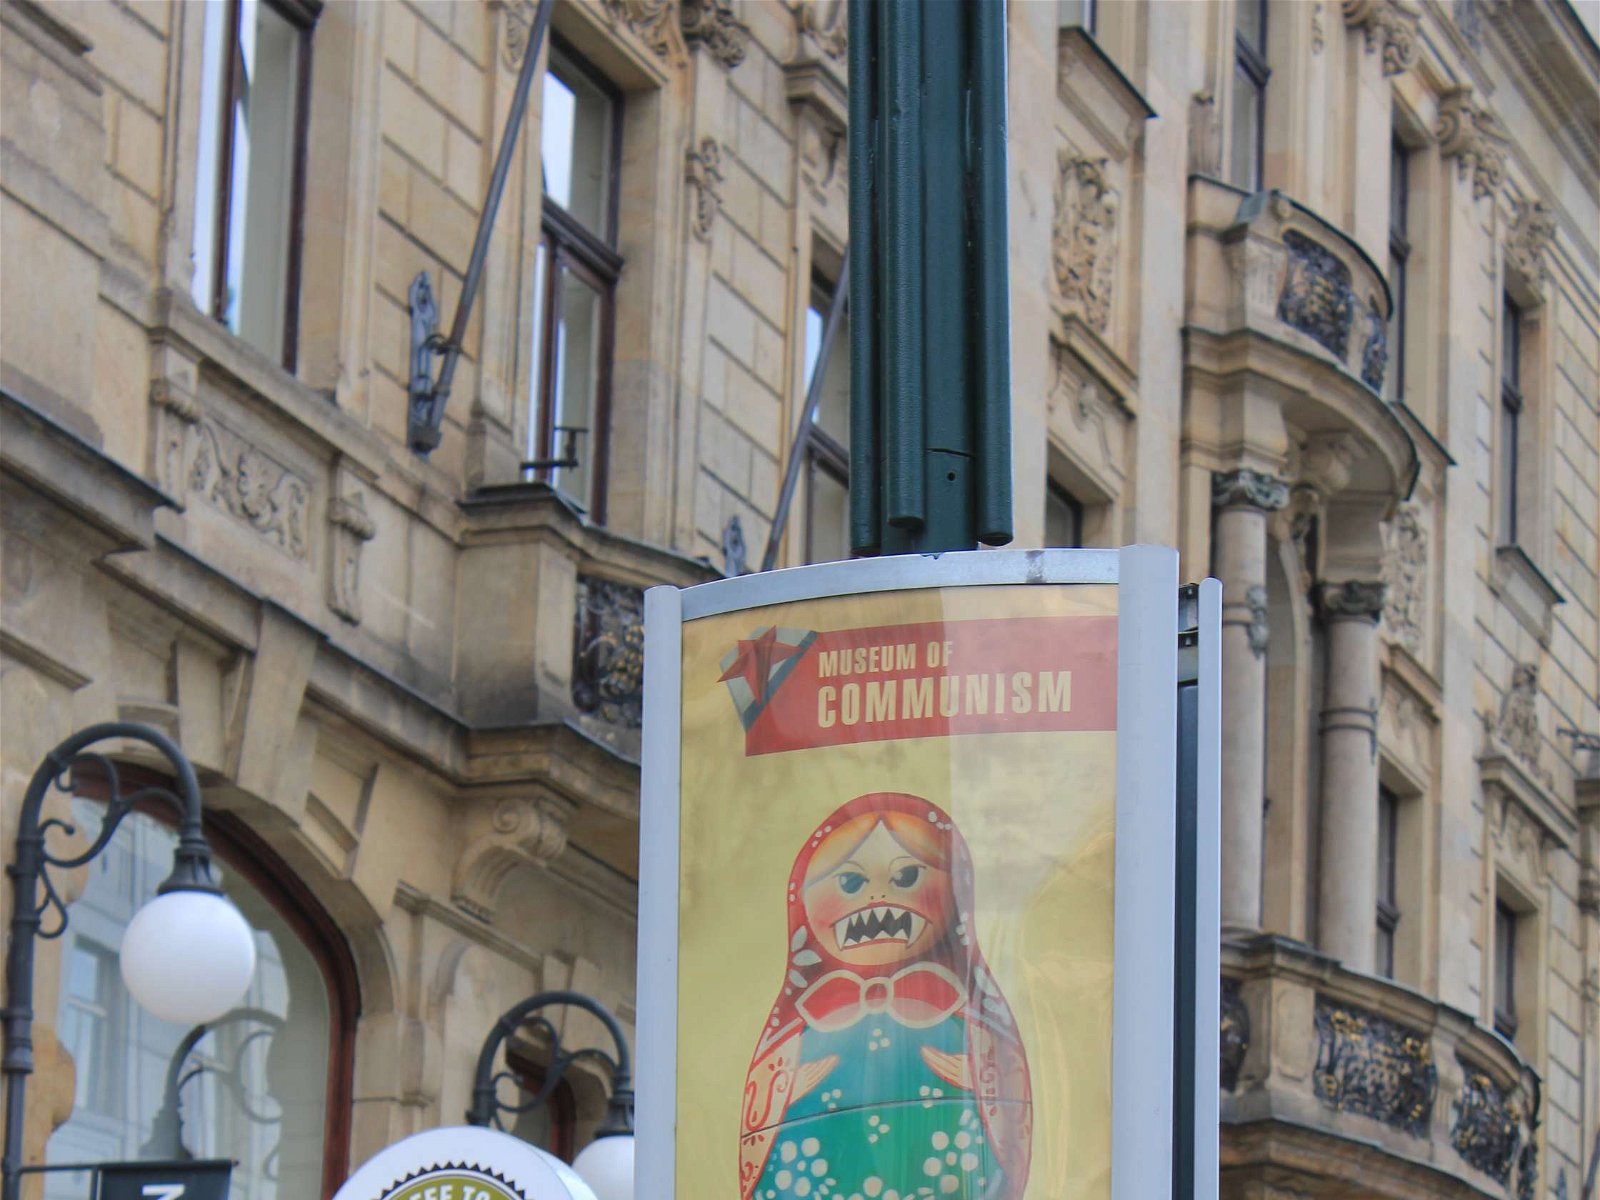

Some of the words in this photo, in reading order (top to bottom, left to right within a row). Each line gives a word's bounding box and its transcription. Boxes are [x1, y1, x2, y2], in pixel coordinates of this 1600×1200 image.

[818, 643, 916, 678] MUSEUM
[927, 641, 953, 667] OF
[818, 670, 1072, 728] COMMUNISM
